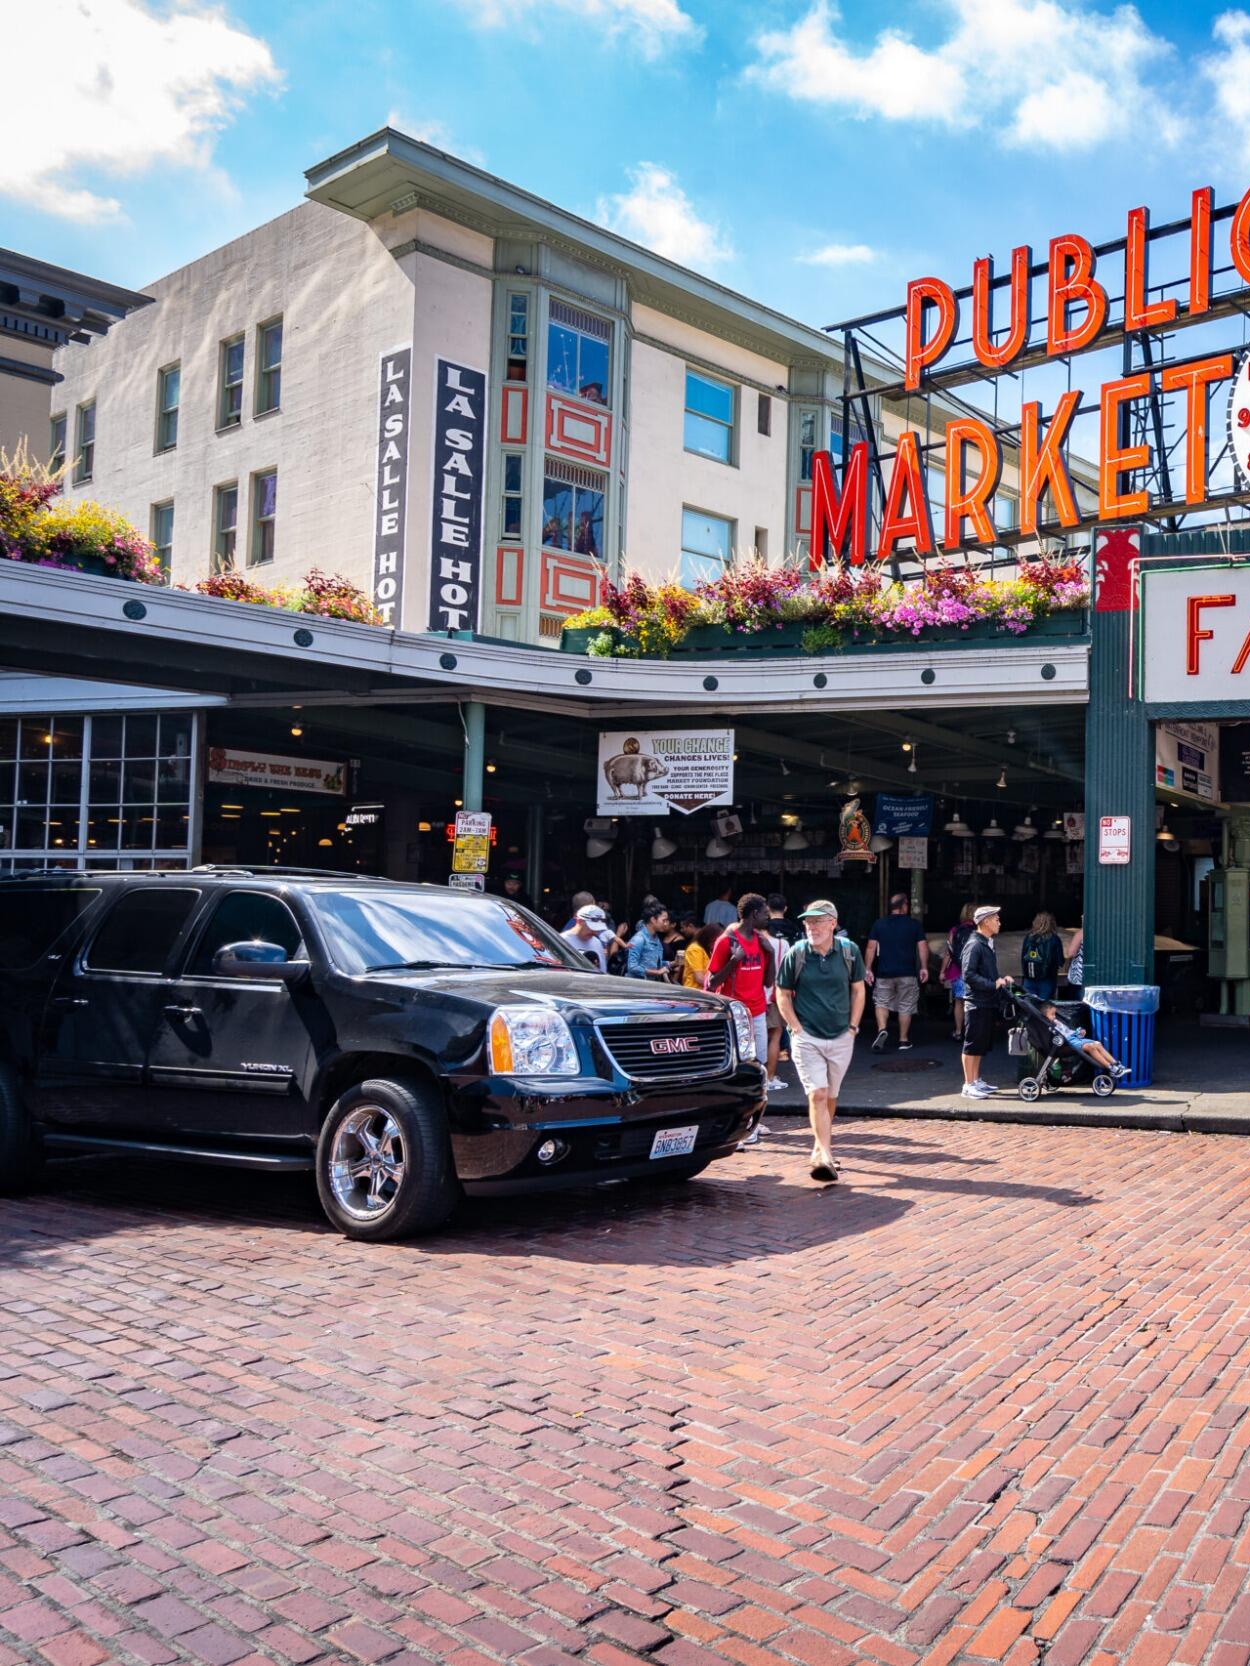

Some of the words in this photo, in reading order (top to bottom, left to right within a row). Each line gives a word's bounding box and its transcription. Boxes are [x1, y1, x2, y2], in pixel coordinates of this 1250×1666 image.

[384, 360, 404, 407] LA
[445, 366, 476, 420] LA
[809, 355, 1233, 571] MARKET
[381, 413, 403, 536] SALLE
[440, 428, 473, 548] SALLE
[377, 551, 398, 630] HOT
[652, 738, 684, 754] YOUR
[684, 737, 730, 754] CHANGE
[664, 754, 703, 762] CHANGES
[703, 754, 730, 762] LIVES!
[289, 780, 315, 789] PRODUCE
[694, 792, 716, 800] HERE!
[461, 819, 486, 827] PARKING
[1104, 828, 1126, 837] STOPS
[649, 1036, 700, 1055] GMC
[240, 1062, 277, 1071] YUKON
[278, 1065, 294, 1073] XL
